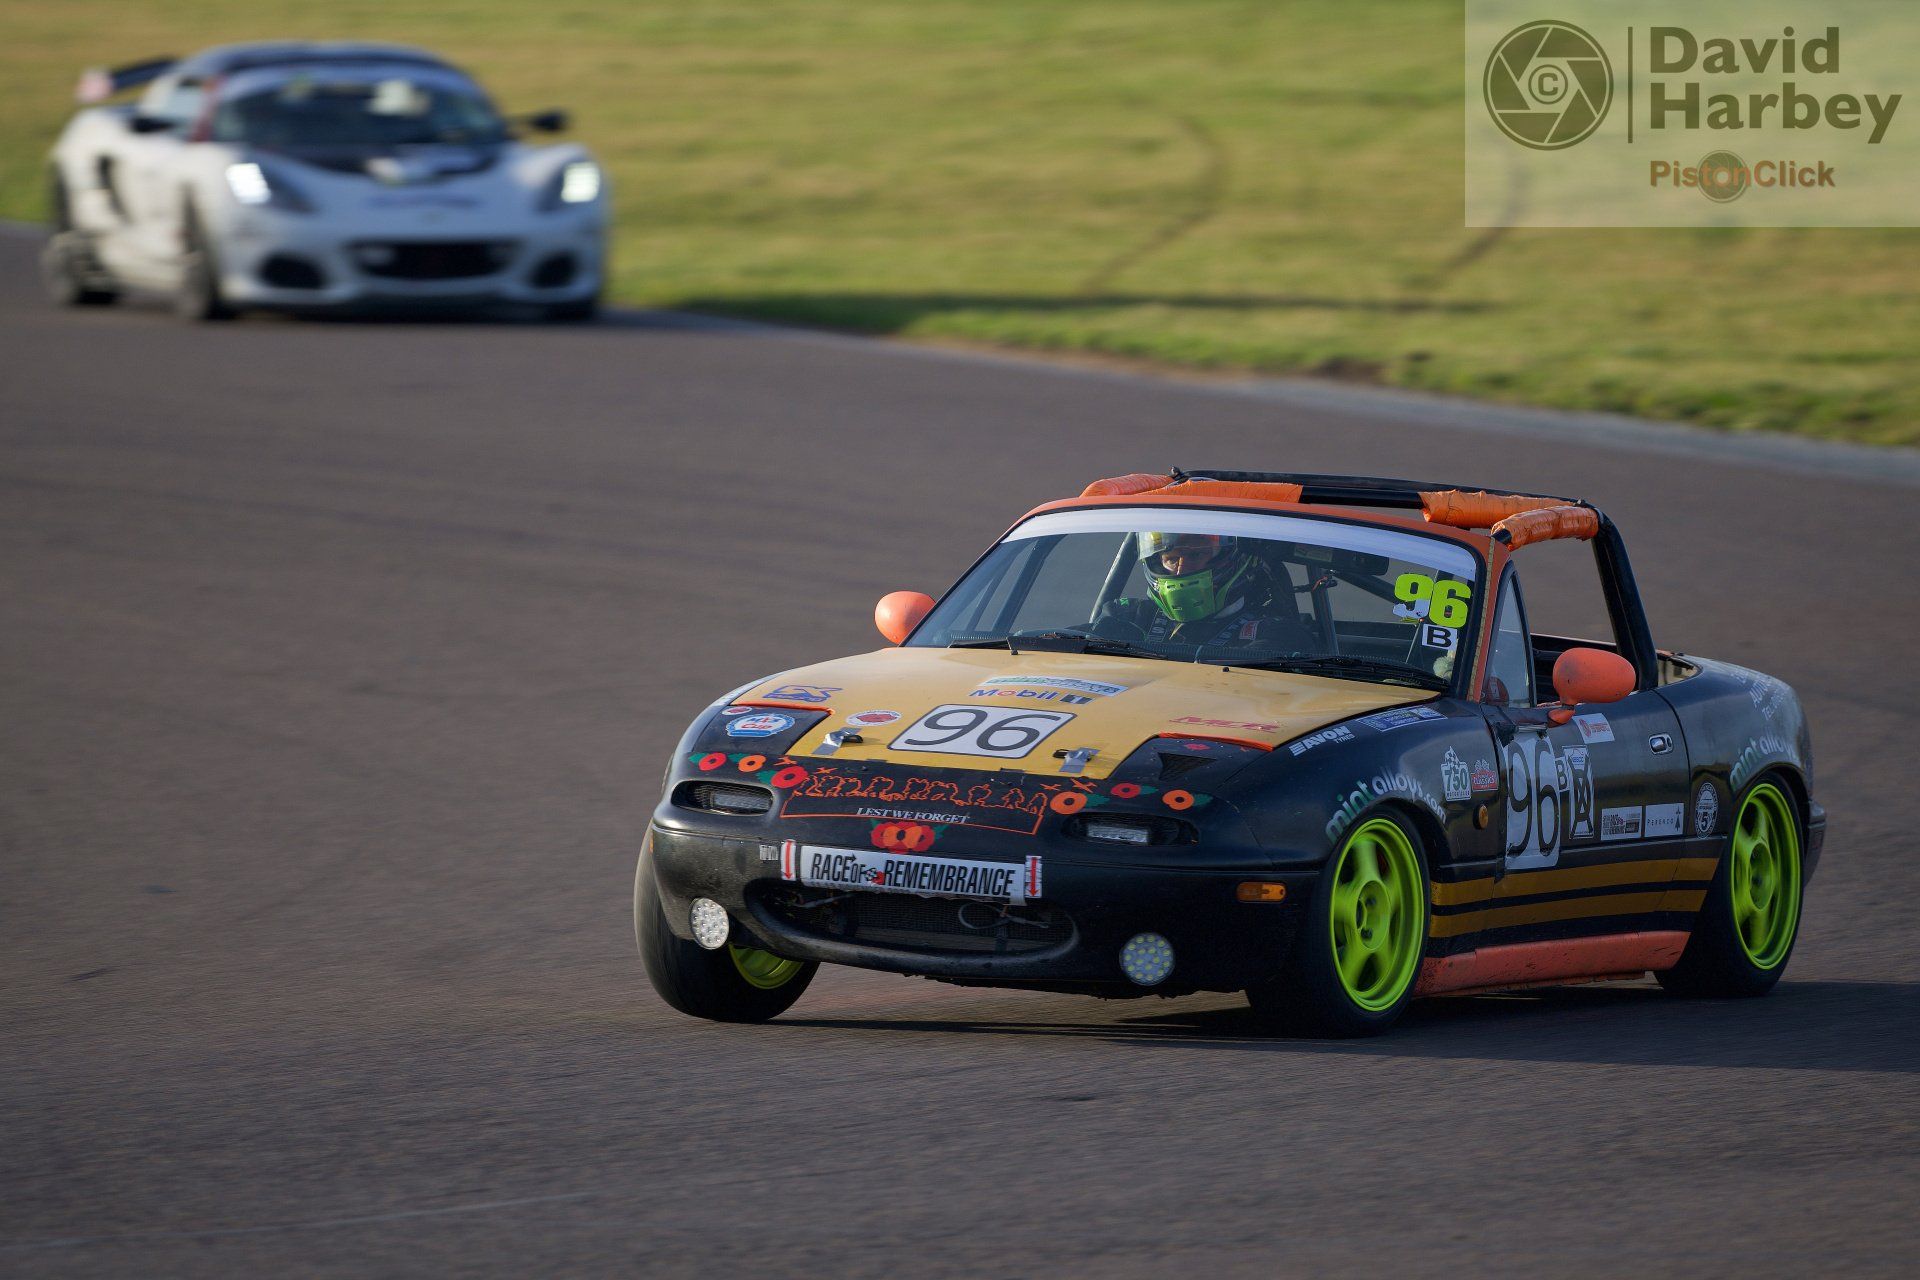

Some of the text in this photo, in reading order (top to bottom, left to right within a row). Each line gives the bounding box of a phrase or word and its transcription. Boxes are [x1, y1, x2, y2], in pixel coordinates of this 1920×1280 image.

[1393, 574, 1471, 628] 96
[1427, 626, 1452, 647] B
[969, 688, 1058, 700] Mobil
[904, 708, 1061, 752] 96
[1302, 725, 1352, 749] AVON
[1445, 768, 1469, 792] 750
[1555, 760, 1569, 790] B
[1506, 740, 1560, 858] 96
[856, 807, 970, 825] LEST WE FORGET
[811, 853, 1017, 897] RACE OF REMEMBRANCE
